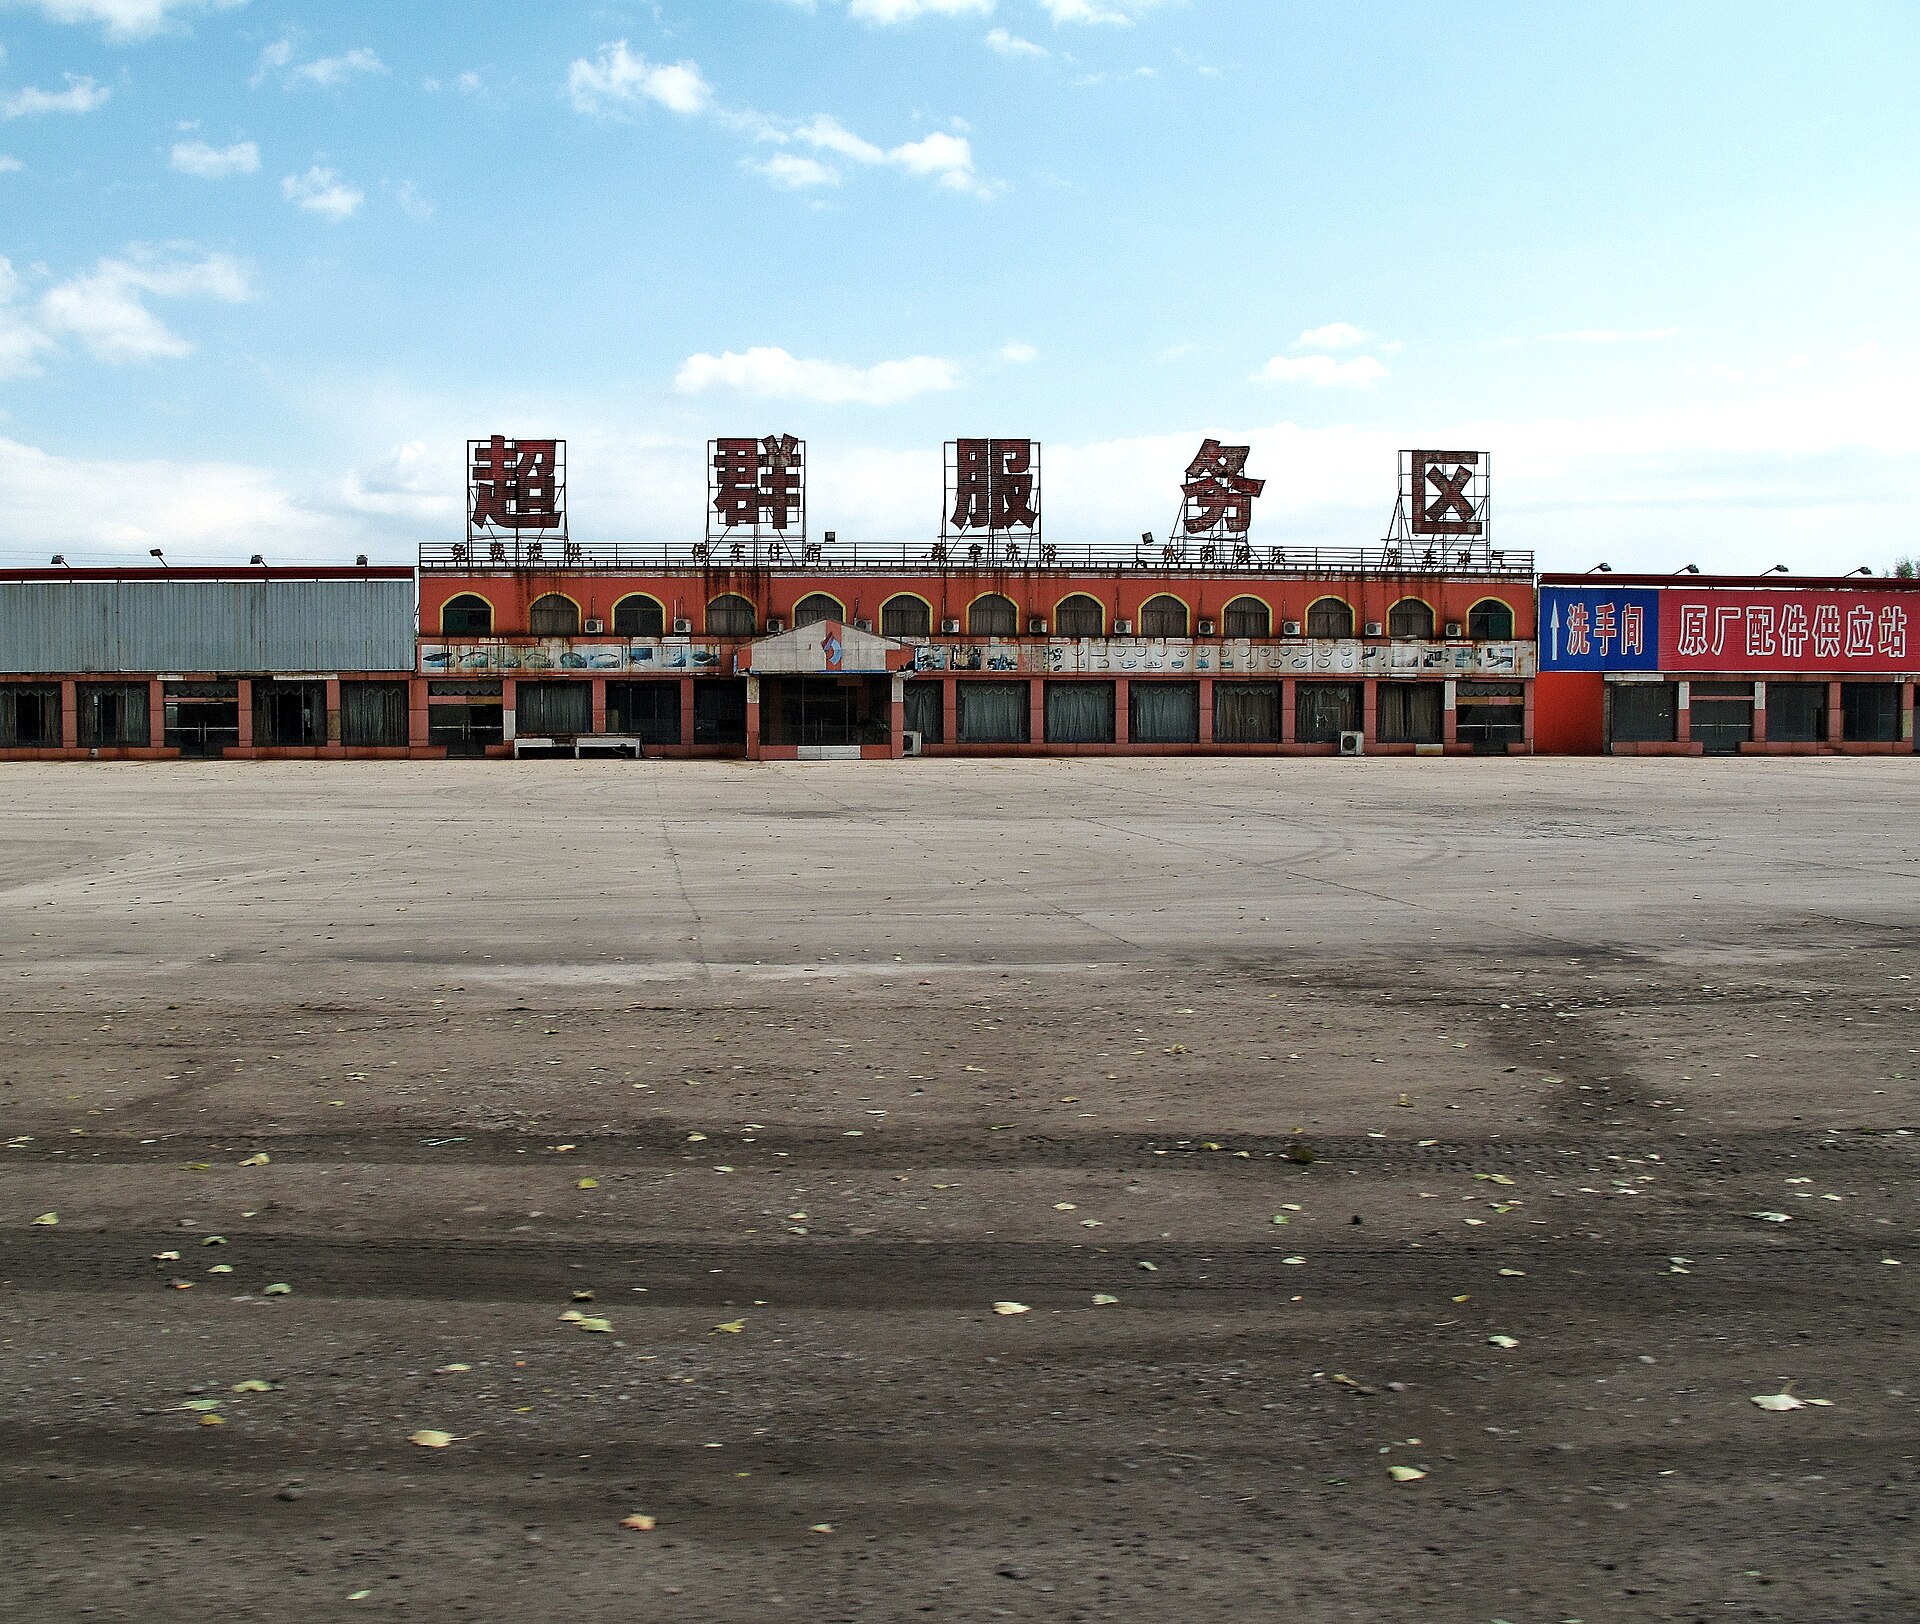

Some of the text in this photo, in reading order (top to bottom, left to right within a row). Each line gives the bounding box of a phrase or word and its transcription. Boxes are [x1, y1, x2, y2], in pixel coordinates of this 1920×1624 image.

[471, 434, 1483, 534] 超群服务区
[1566, 602, 1643, 656] 洗手间
[1677, 604, 1908, 658] 原厂配件供应站
